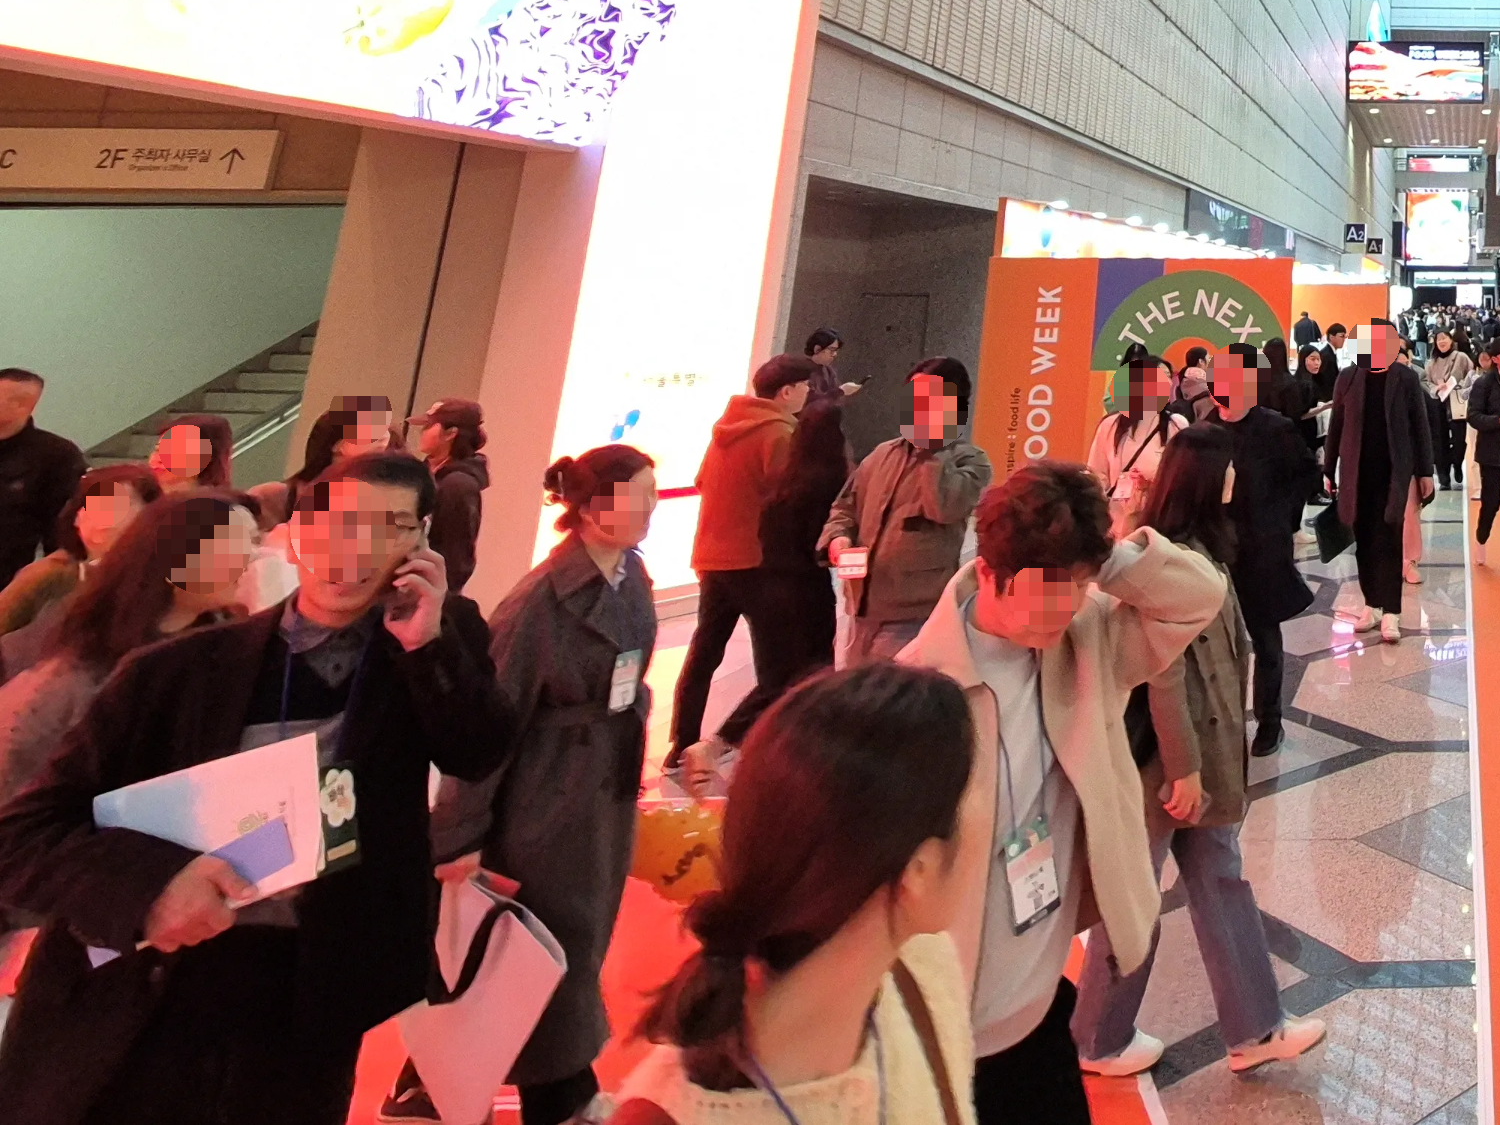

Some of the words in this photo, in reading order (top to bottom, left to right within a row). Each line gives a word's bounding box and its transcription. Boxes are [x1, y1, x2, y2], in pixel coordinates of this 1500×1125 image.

[94, 148, 129, 169] 2F
[172, 148, 212, 163] 사무실
[1347, 226, 1364, 241] A2
[1368, 240, 1382, 252] A1
[1117, 290, 1185, 345] THE
[1192, 289, 1266, 347] NEX
[1030, 285, 1063, 375] WEEK
[1010, 387, 1021, 405] life
[1007, 406, 1019, 432] food
[1023, 383, 1053, 460] OOD
